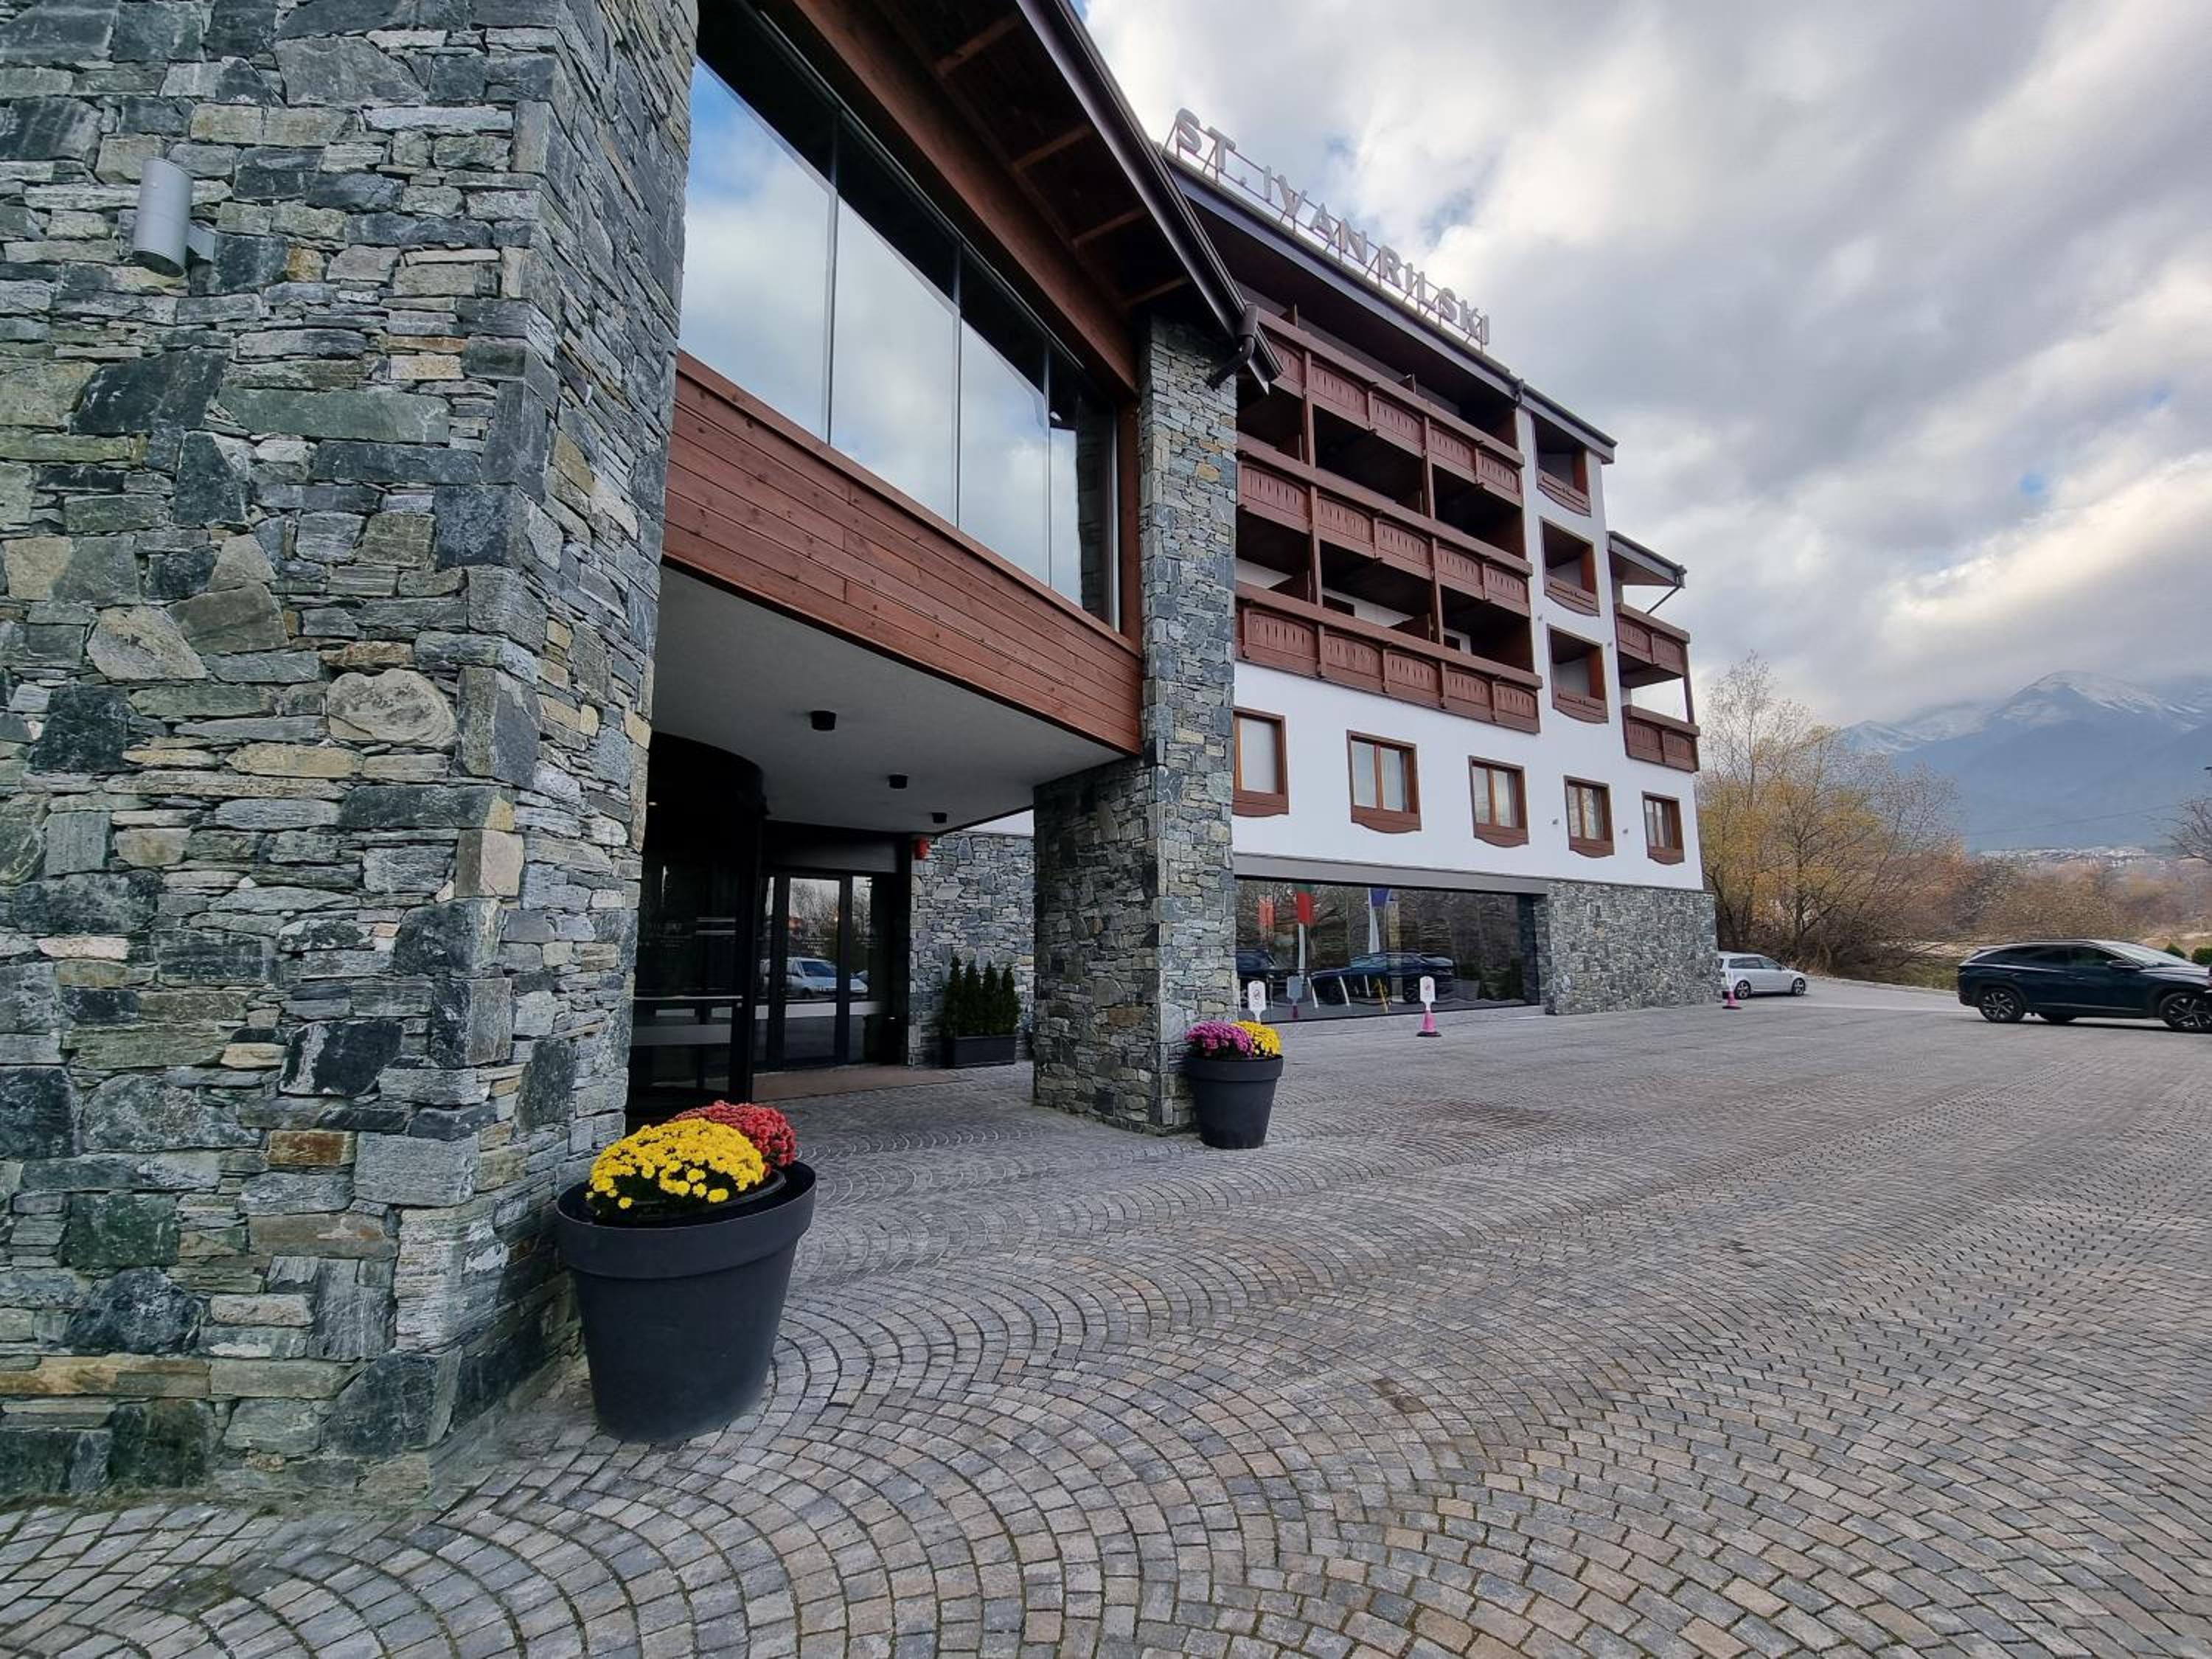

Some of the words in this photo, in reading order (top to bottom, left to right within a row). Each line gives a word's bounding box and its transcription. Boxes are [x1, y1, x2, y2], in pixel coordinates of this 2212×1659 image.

[1175, 108, 1247, 186] ST.
[1263, 165, 1367, 264] IVAN
[1380, 246, 1489, 345] RILSKI
